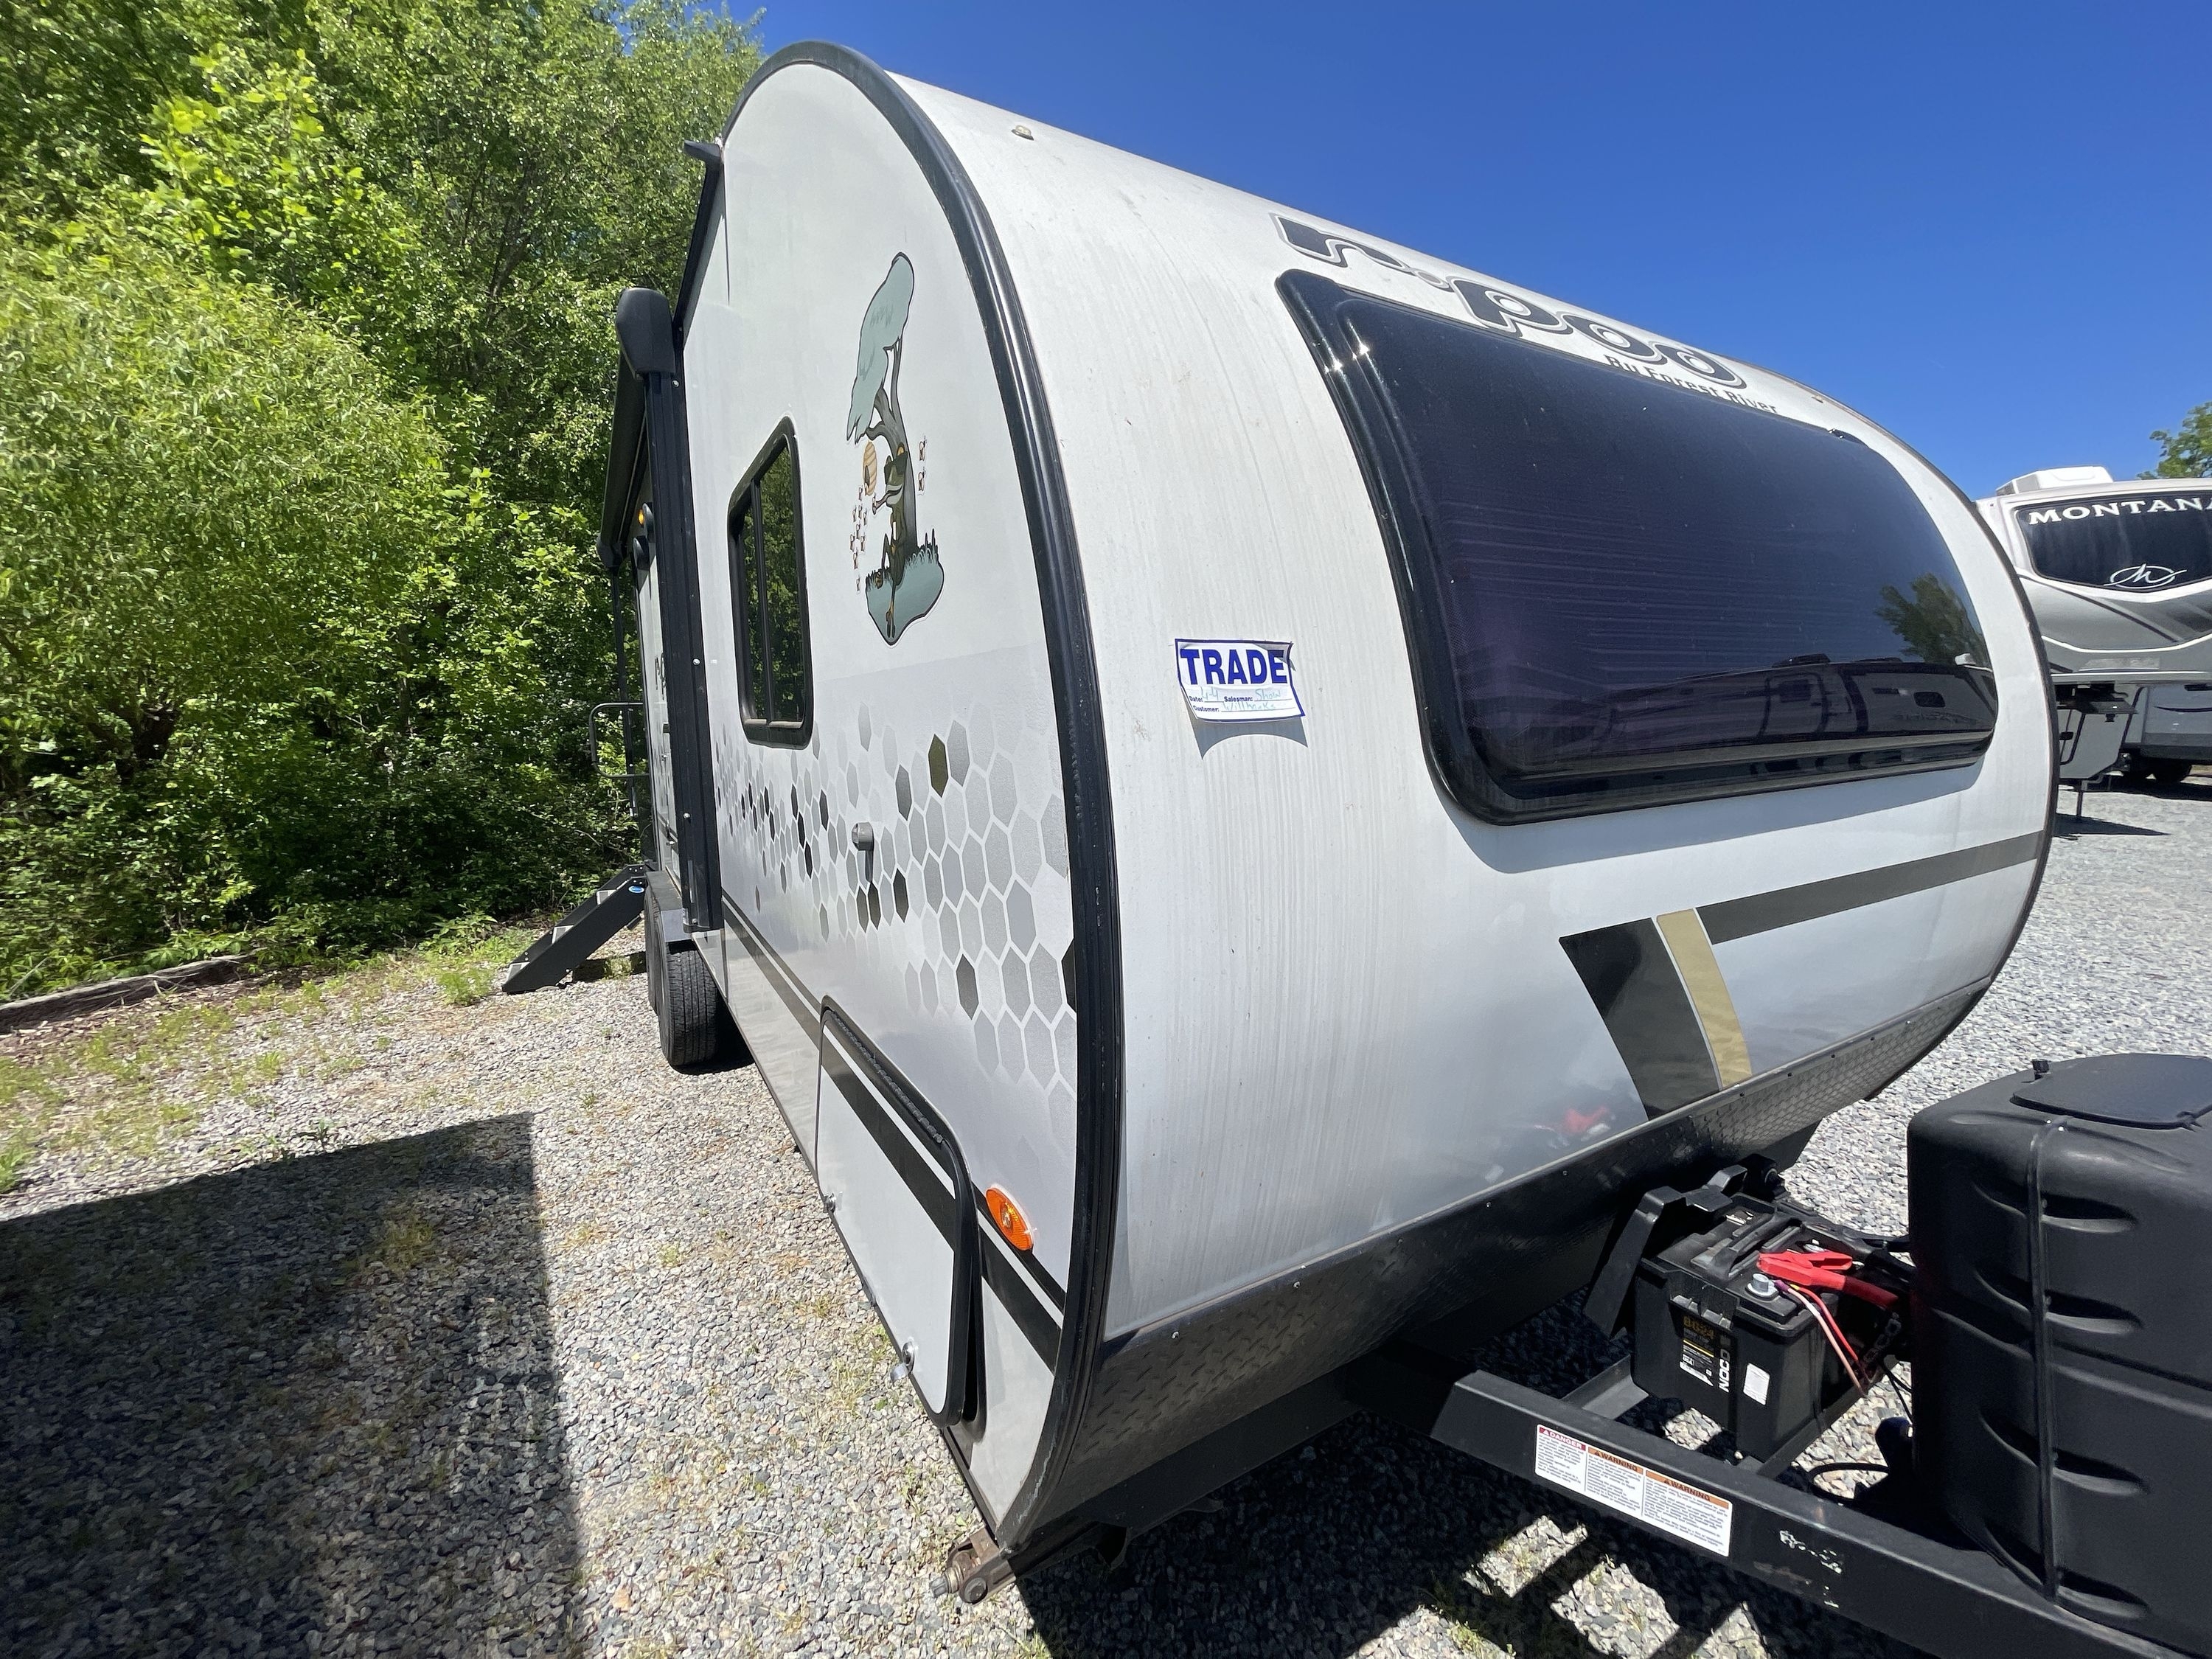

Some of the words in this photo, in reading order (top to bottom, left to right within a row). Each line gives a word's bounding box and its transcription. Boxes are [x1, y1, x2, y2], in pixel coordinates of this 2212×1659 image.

[1644, 366, 1719, 397] Forest
[1725, 389, 1778, 414] River
[1180, 648, 1287, 685] TRADE
[1192, 705, 1220, 713] Customer:
[1719, 1349, 1731, 1393] NOCO
[1550, 1431, 1582, 1449] DANGER
[1601, 1453, 1638, 1472] WARNING
[1670, 1481, 1711, 1501] WARNING
